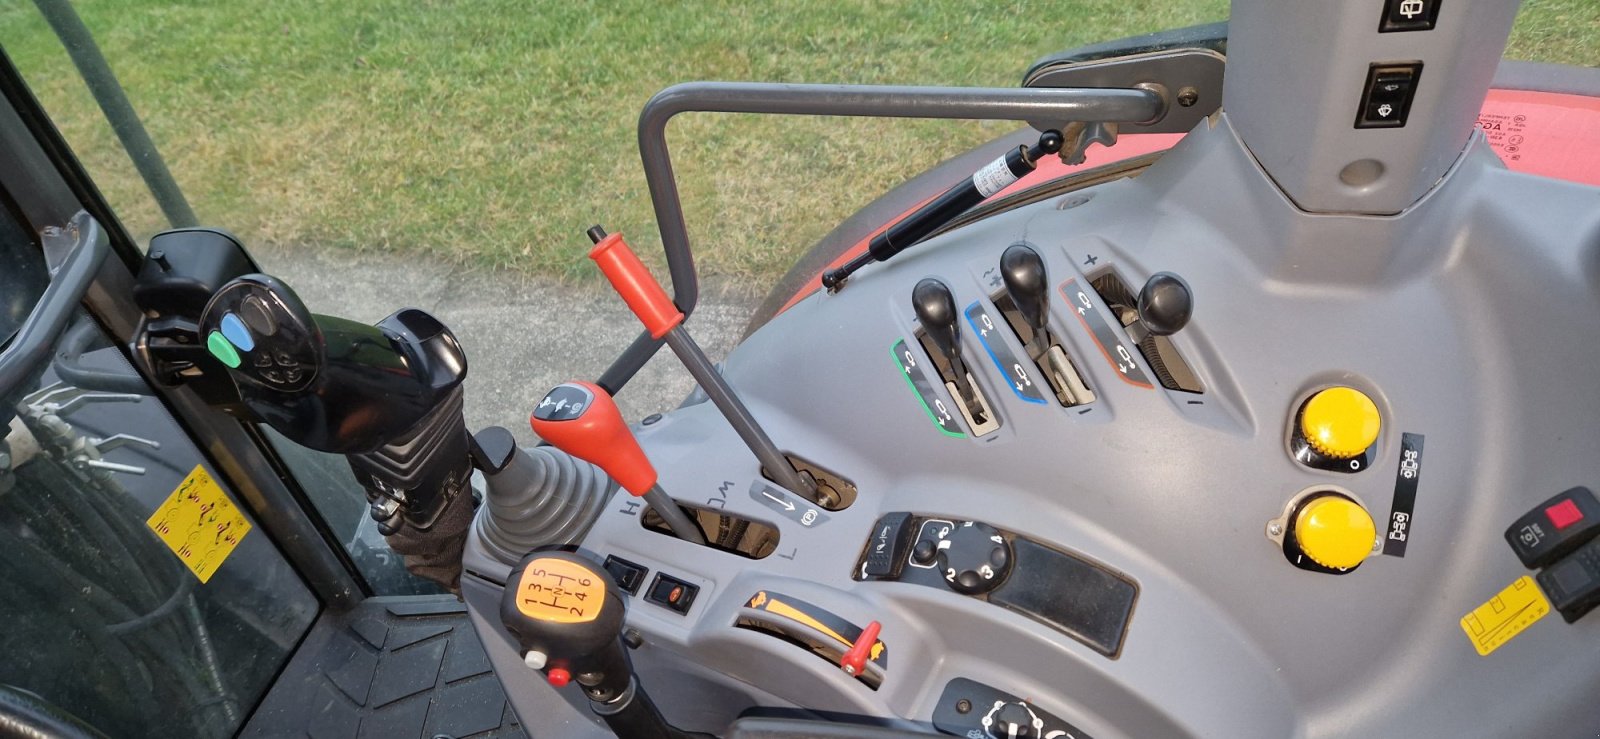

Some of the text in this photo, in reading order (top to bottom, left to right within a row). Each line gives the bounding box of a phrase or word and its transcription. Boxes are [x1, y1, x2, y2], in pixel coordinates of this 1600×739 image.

[619, 501, 640, 515] H
[990, 535, 1002, 544] 4
[779, 548, 797, 560] L
[533, 568, 546, 578] 5
[946, 567, 956, 582] 2
[981, 565, 994, 579] 3
[528, 583, 542, 592] 3
[569, 578, 591, 617] 2 4 6
